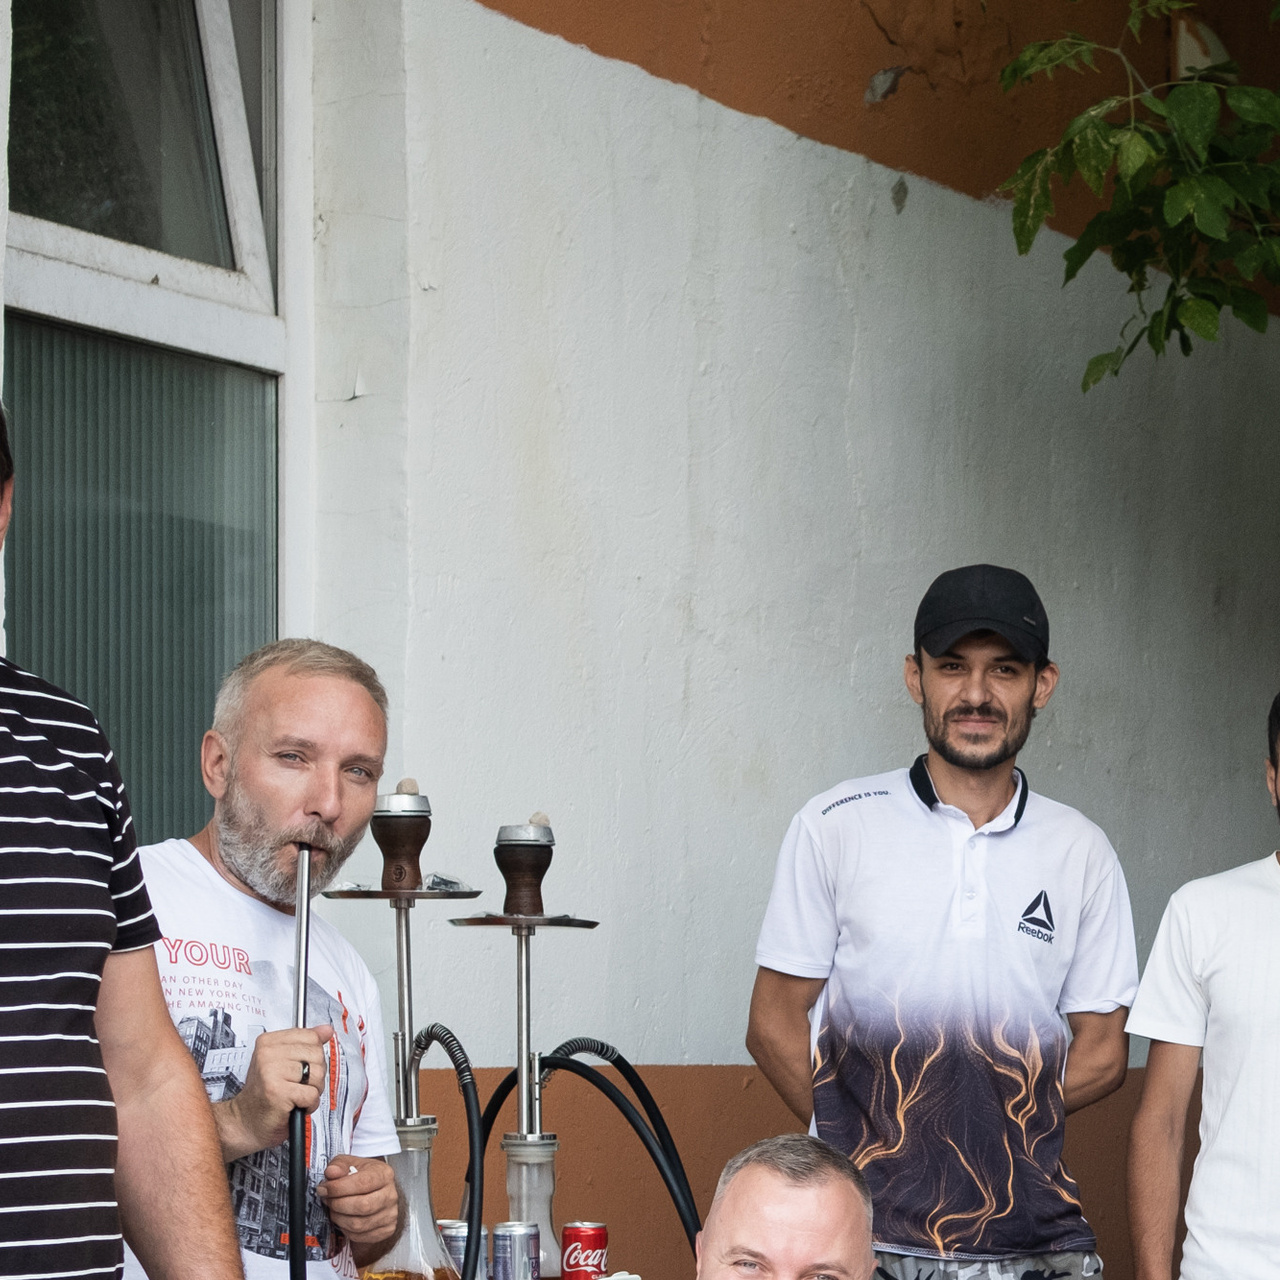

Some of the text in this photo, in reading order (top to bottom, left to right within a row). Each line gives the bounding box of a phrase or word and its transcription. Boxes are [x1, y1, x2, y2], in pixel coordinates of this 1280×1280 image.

[821, 793, 863, 816] DIFFERENCE
[1017, 921, 1055, 944] Reebok
[161, 937, 253, 976] YOUR
[161, 975, 244, 991] AN OTHER DAY
[178, 987, 205, 997] NEW
[209, 989, 238, 1000] YORK
[241, 993, 263, 1005] CITY
[167, 999, 267, 1018] HE AMAZING TIME
